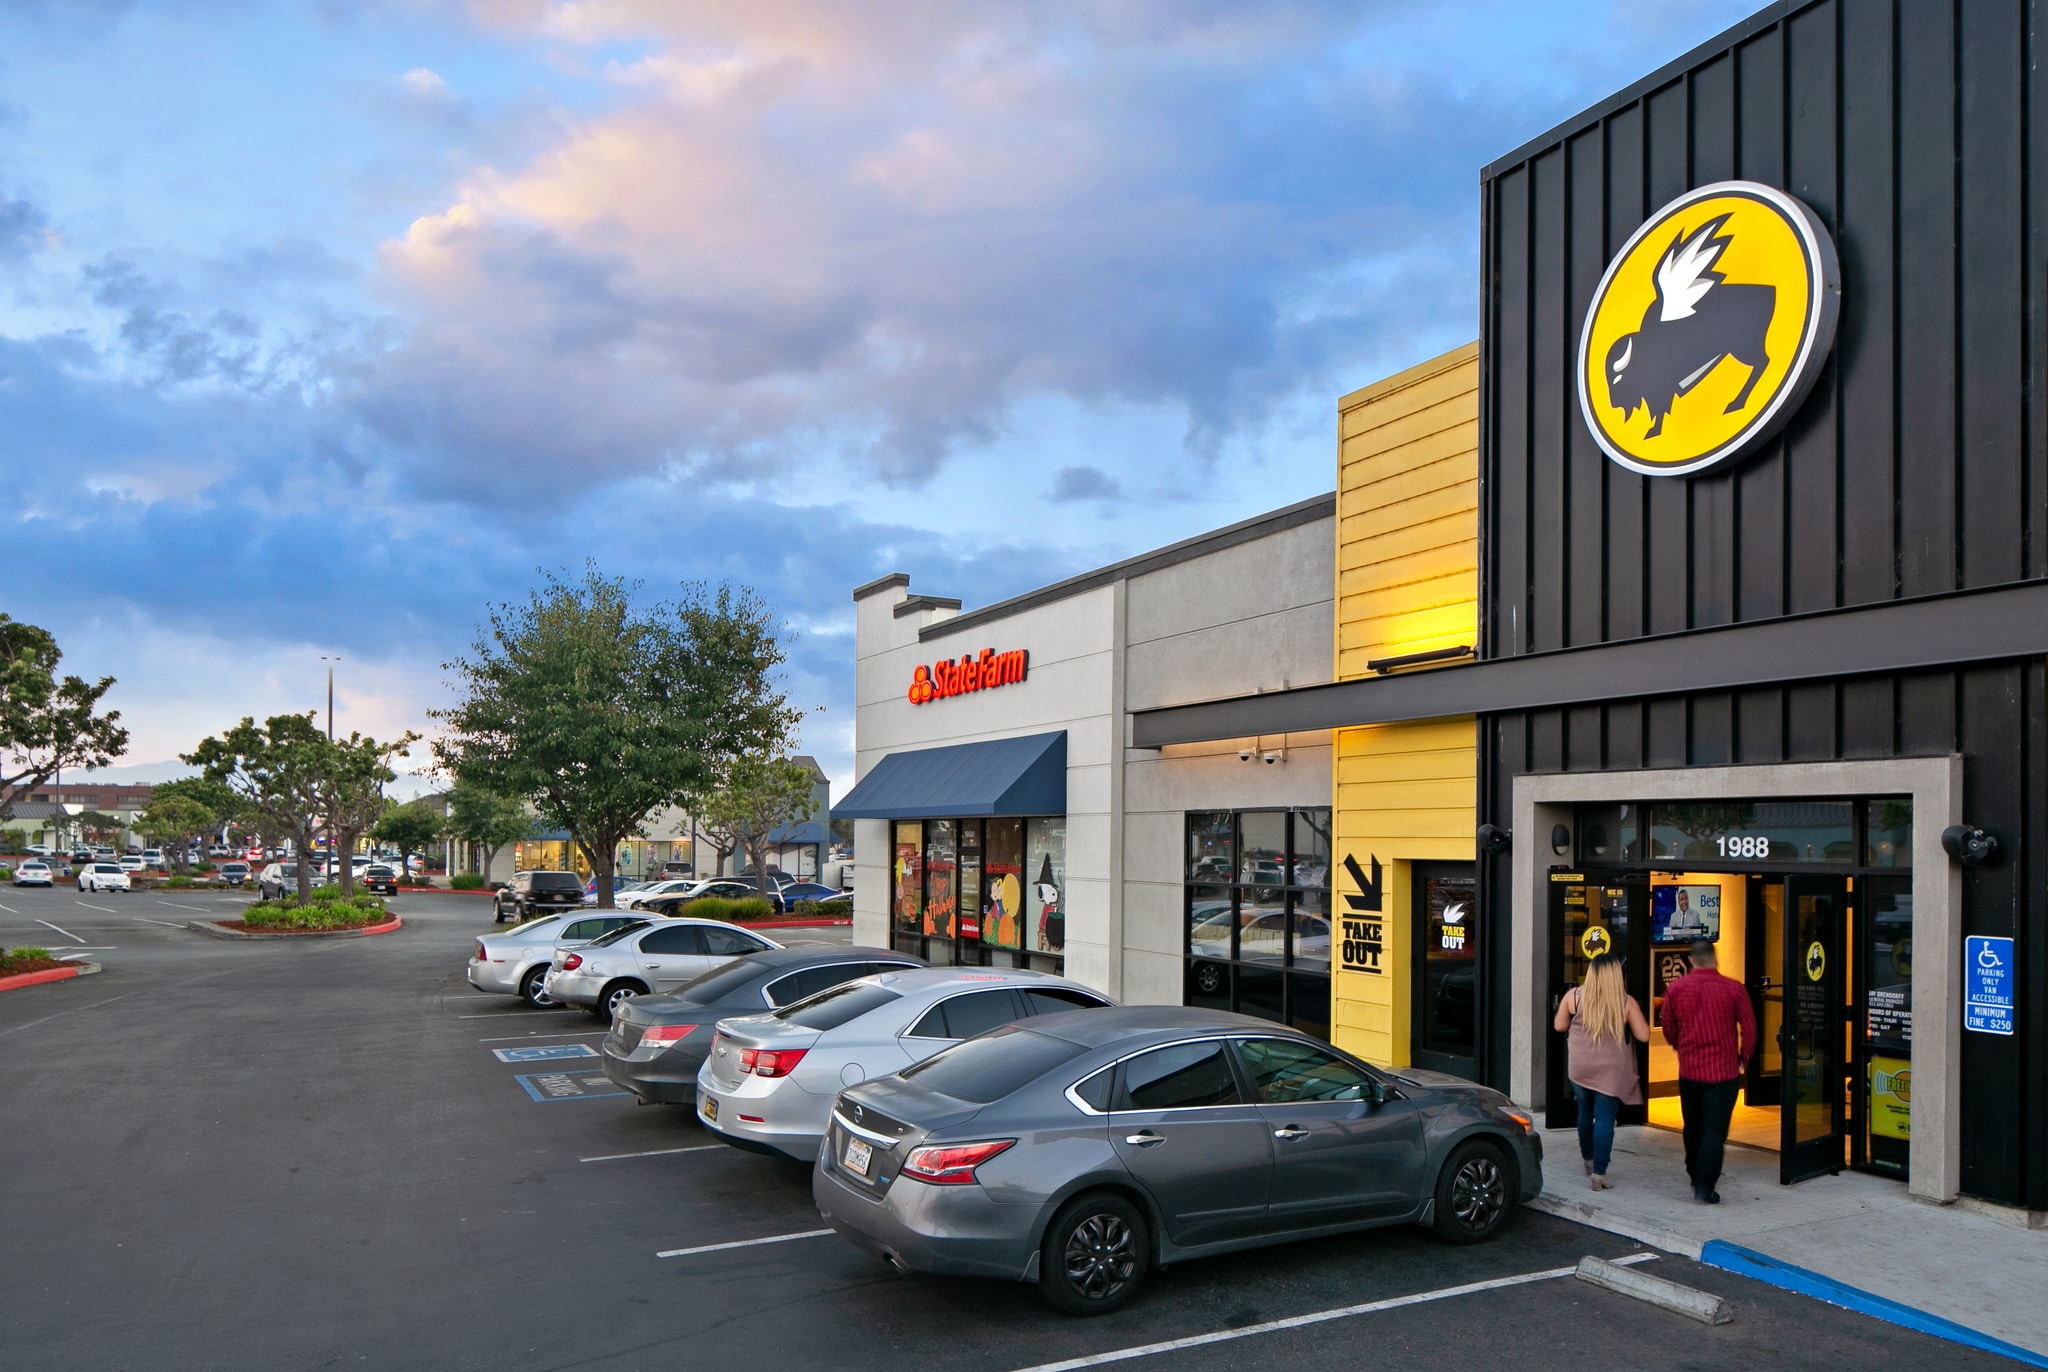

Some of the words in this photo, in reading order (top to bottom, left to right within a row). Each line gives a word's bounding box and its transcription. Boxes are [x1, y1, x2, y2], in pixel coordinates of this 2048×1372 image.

[1716, 836, 1769, 858] 1988
[1700, 895, 1720, 908] Best
[1342, 921, 1382, 942] TAKE
[1442, 925, 1465, 937] TAKE
[1442, 935, 1465, 950] OUT
[1342, 940, 1382, 966] OUT
[1977, 968, 2005, 978] PARKING
[1982, 977, 1999, 986] ONLY
[1984, 986, 1997, 995] VAN
[1972, 993, 2009, 1005] ACCESSIBLE
[1974, 1006, 2006, 1018] MINIMUM
[1969, 1017, 1985, 1027] FINE
[1990, 1019, 2011, 1030] $250
[534, 1074, 584, 1097] PARKING
[1887, 1076, 1906, 1092] FREE
